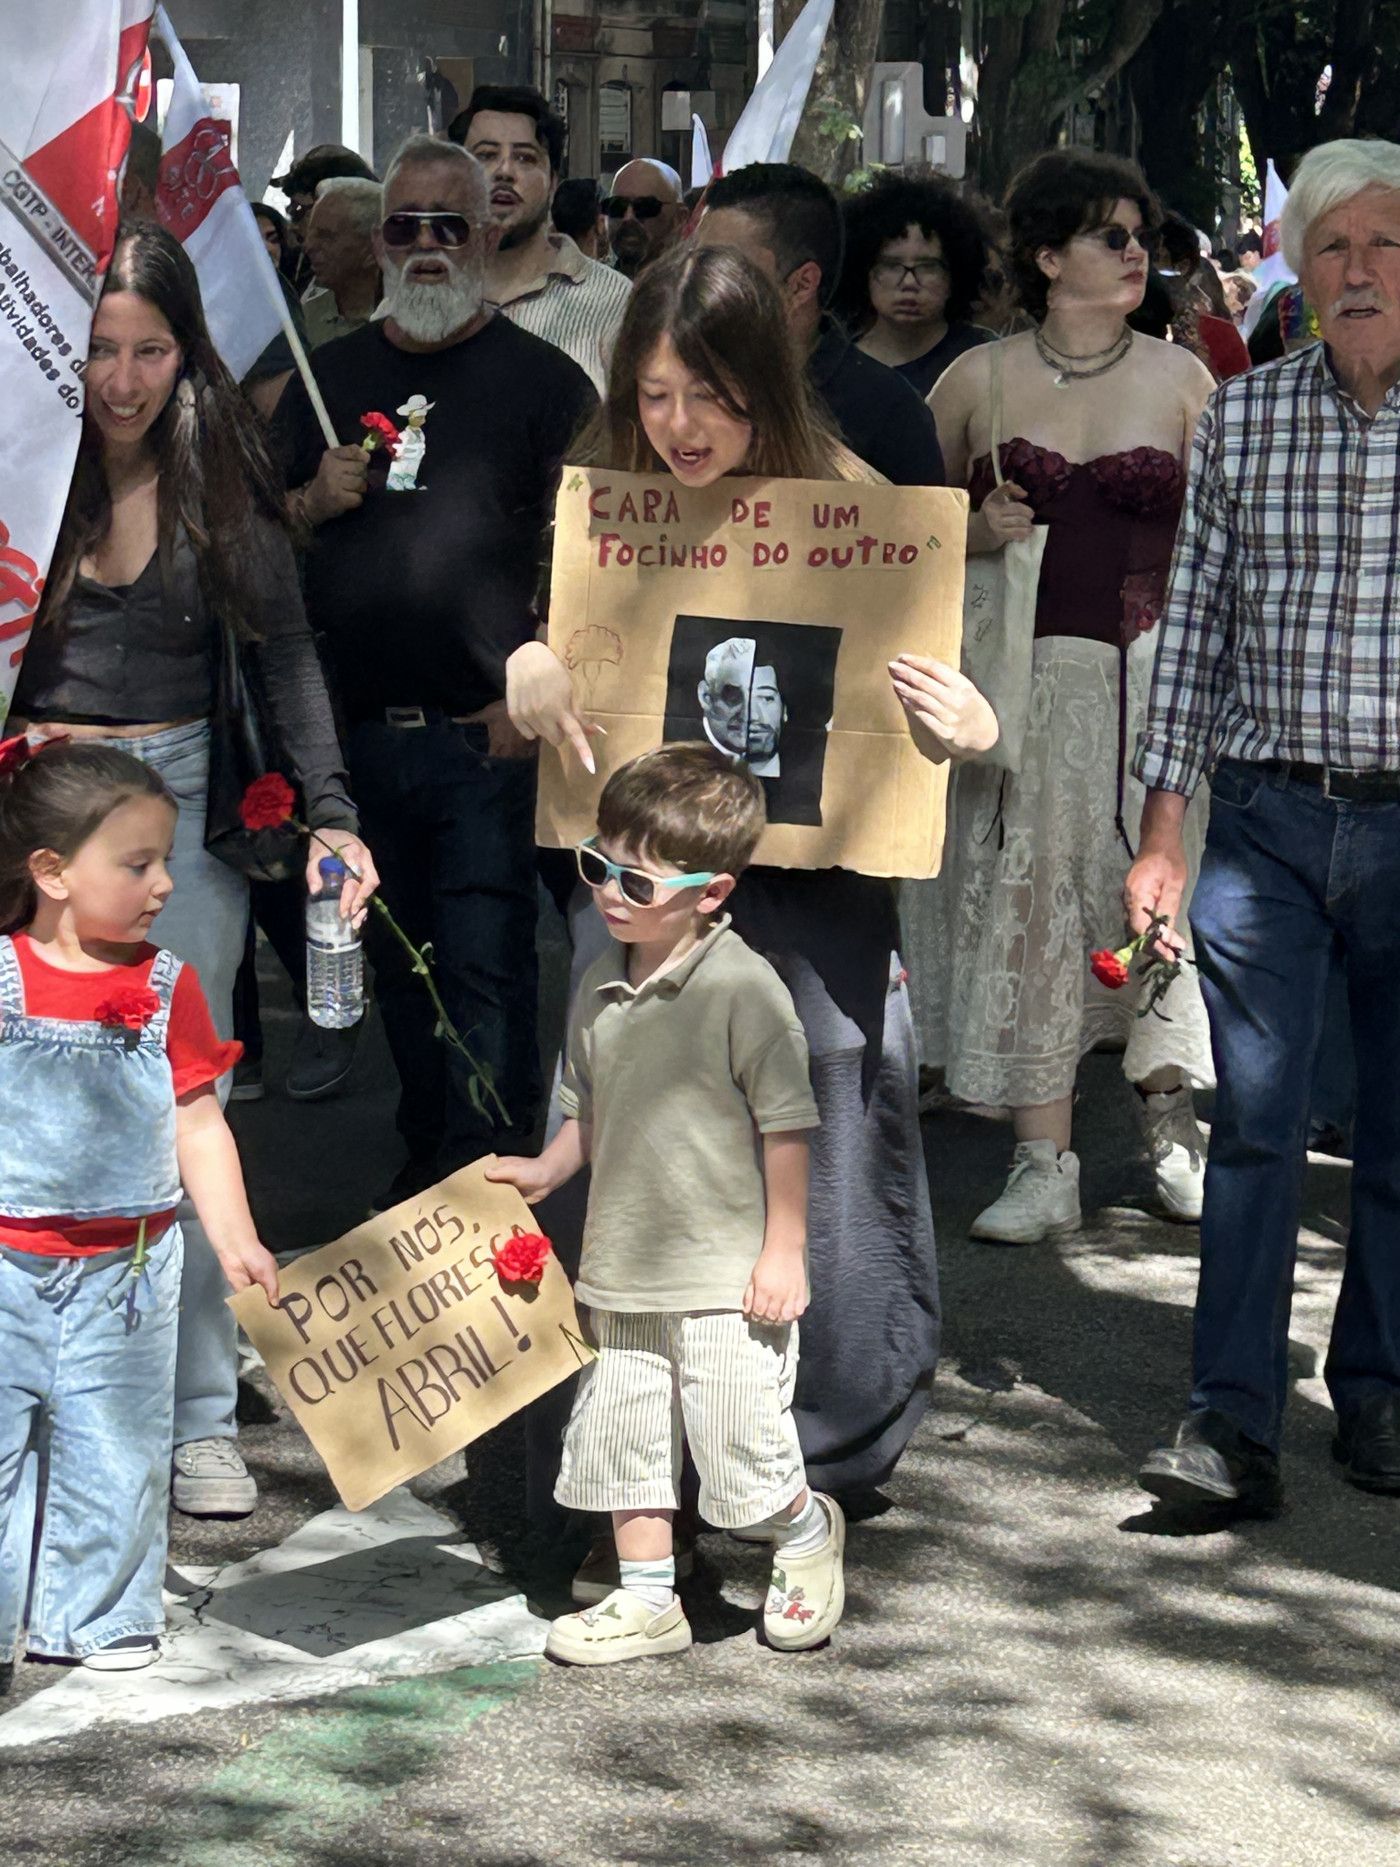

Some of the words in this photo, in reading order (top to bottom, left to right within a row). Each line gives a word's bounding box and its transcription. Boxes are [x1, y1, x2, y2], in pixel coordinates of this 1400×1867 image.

[731, 499, 772, 528] DE
[812, 504, 859, 529] UM
[753, 541, 789, 567] DO
[277, 1258, 378, 1344] POR
[289, 1324, 380, 1405] QUE
